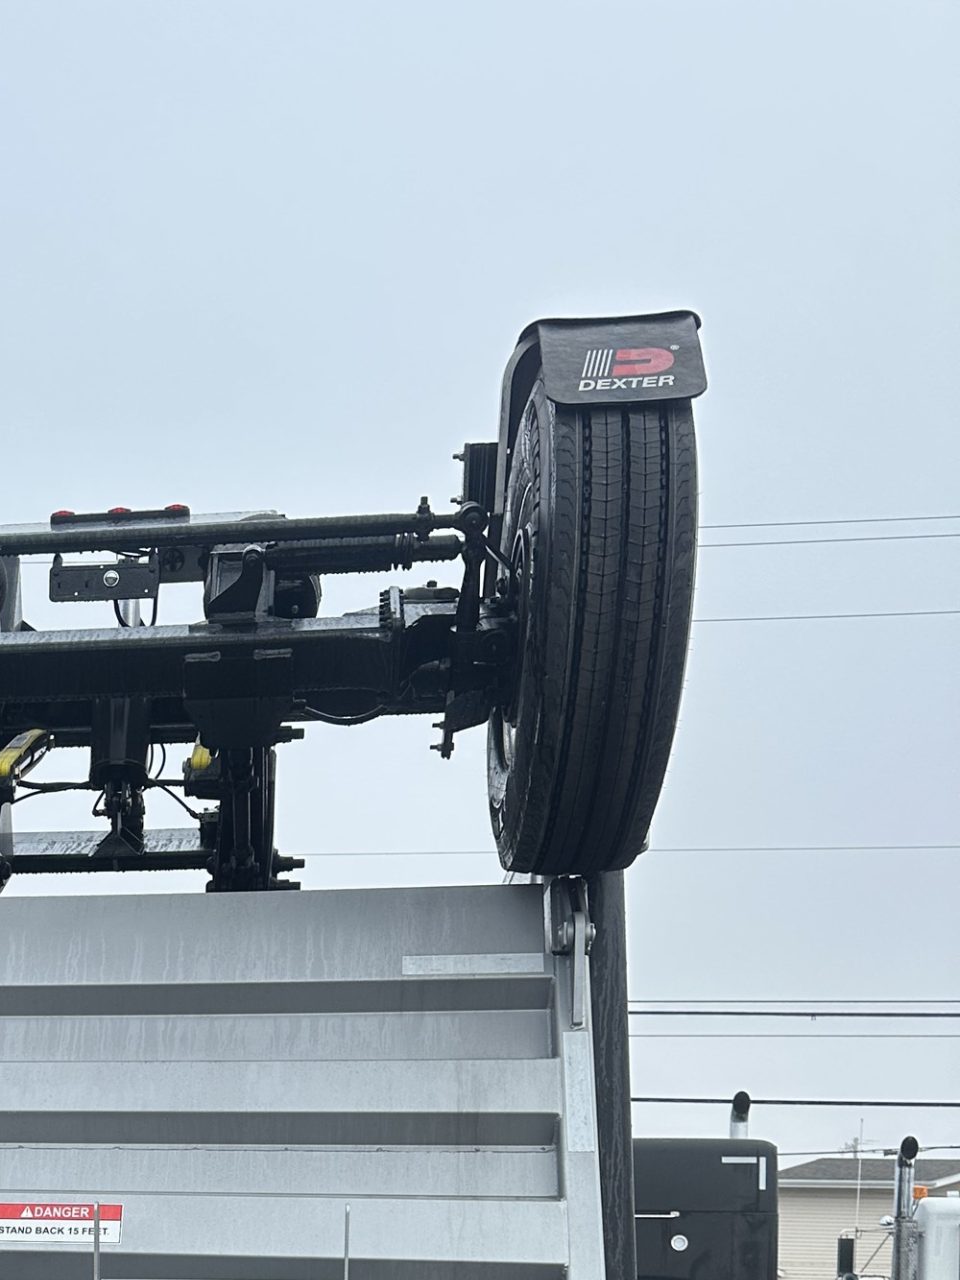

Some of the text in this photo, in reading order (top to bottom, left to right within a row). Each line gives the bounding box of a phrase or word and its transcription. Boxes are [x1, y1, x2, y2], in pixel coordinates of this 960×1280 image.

[578, 375, 675, 391] DEXTER
[34, 1206, 90, 1218] DANGER
[35, 1226, 65, 1235] BACK
[68, 1227, 79, 1235] 15
[82, 1227, 110, 1236] FET.
